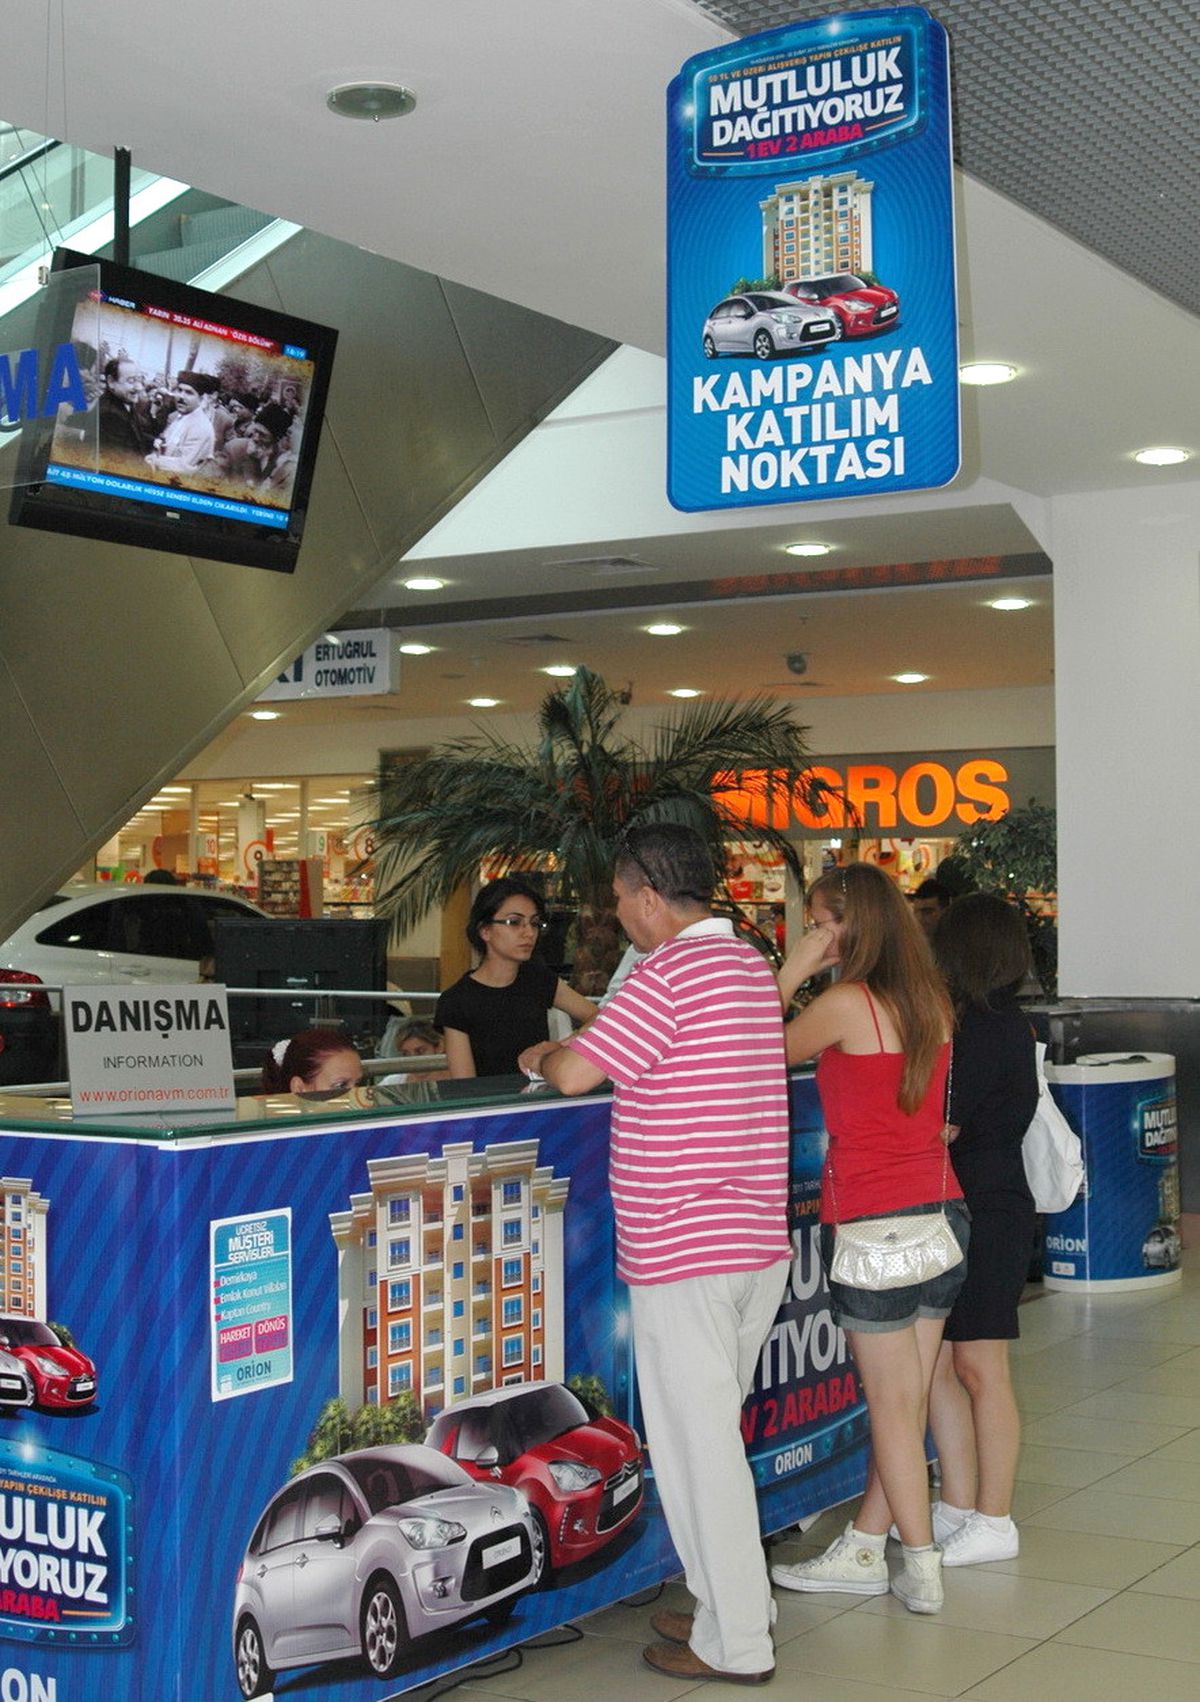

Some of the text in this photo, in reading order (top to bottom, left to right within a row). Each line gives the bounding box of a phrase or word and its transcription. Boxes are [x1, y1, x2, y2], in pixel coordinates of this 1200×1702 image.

[730, 70, 741, 78] VE
[809, 51, 832, 61] YAPIN
[870, 35, 902, 49] KATILIN
[710, 46, 903, 116] MUTLULUK
[712, 84, 904, 147] DAĞITIYORUZ
[747, 122, 864, 159] 1 EV 2 ARABA
[693, 347, 933, 413] KAMPANYA
[726, 394, 899, 452] KATILIM
[721, 436, 905, 493] NOKTASI
[105, 479, 142, 492] DOLARLIK
[315, 639, 376, 661] ERTUĞRUL
[315, 663, 376, 686] OTOMOTİV
[709, 759, 1010, 831] MIGROS
[71, 999, 226, 1039] DANIŞMA
[103, 1054, 204, 1069] INFORMATION
[79, 1086, 230, 1102] www.orionavm.com.tr
[236, 1360, 272, 1381] ORİON
[763, 1399, 778, 1438] 2
[782, 1372, 857, 1431] ARABA
[775, 1442, 813, 1475] ORİON
[27, 1484, 68, 1500] ÇEKİLİŞE
[70, 1490, 107, 1506] KATILIN
[0, 1588, 61, 1622] RABA
